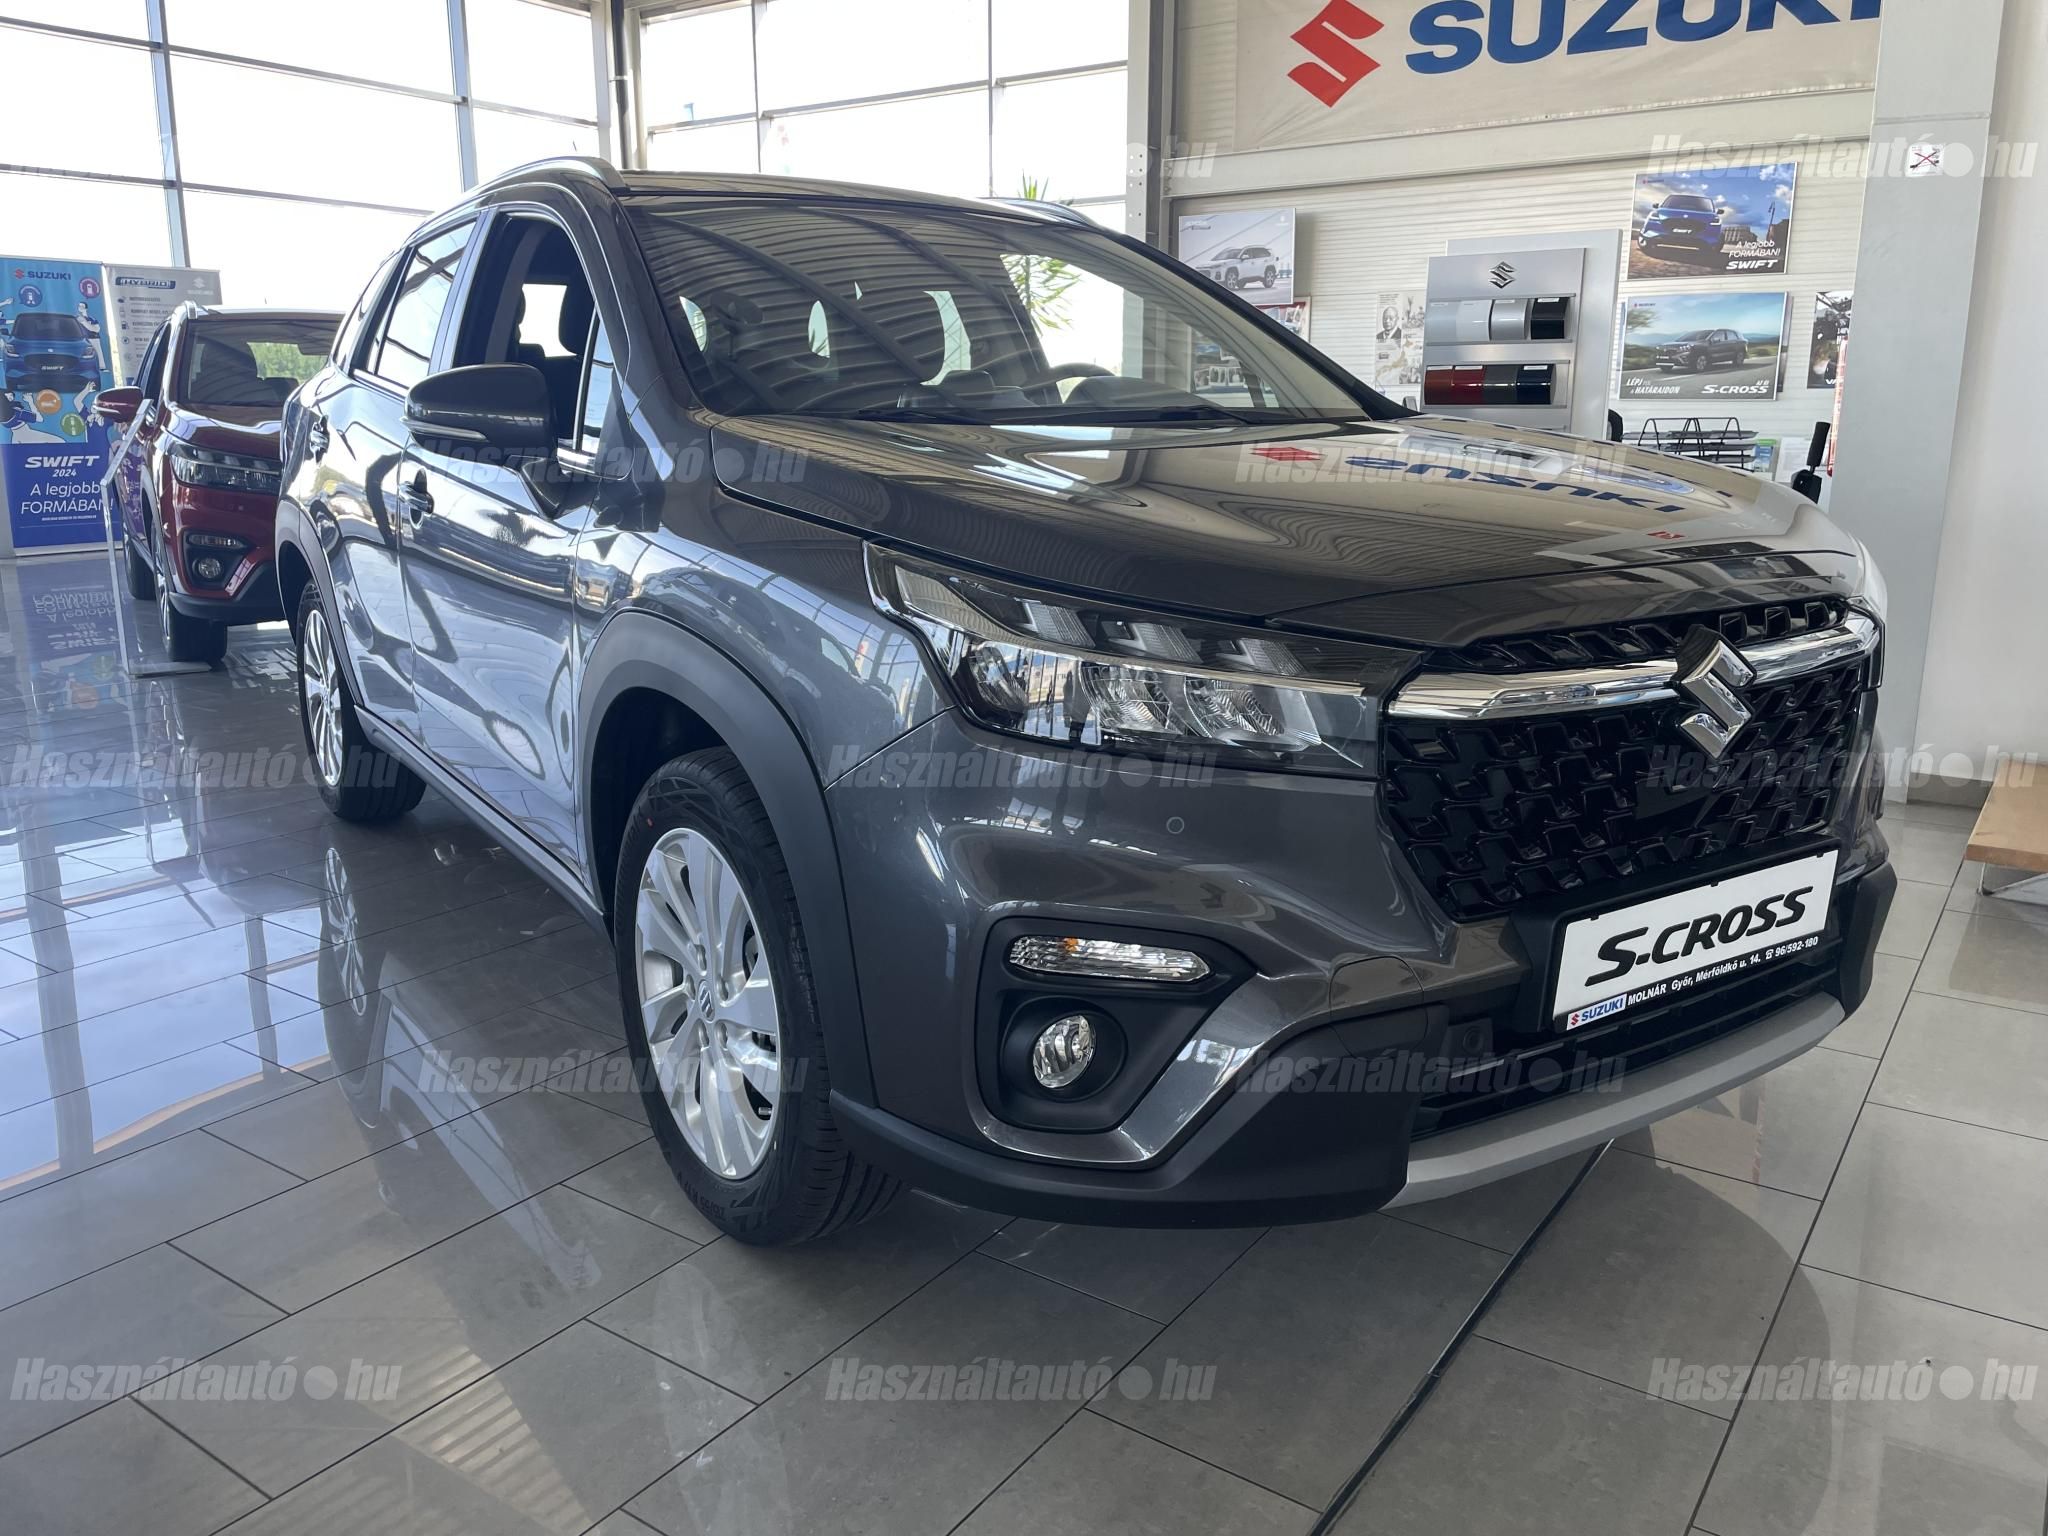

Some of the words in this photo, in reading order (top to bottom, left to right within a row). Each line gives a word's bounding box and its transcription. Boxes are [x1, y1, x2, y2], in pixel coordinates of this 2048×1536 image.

[1405, 0, 1880, 74] SUZU
[1735, 241, 1742, 249] A
[1726, 260, 1778, 270] SWIFT
[28, 271, 71, 280] SUZUKI
[25, 456, 99, 468] SWIFT
[52, 469, 77, 477] 2024
[30, 483, 41, 496] A
[46, 481, 100, 498] legjobb
[1582, 998, 1624, 1021] SUZUKI
[1628, 984, 1667, 1006] MOLNÁR
[1671, 976, 1694, 991] Győr,
[1695, 960, 1738, 982] Mérföldkő
[1750, 953, 1761, 965] 14.
